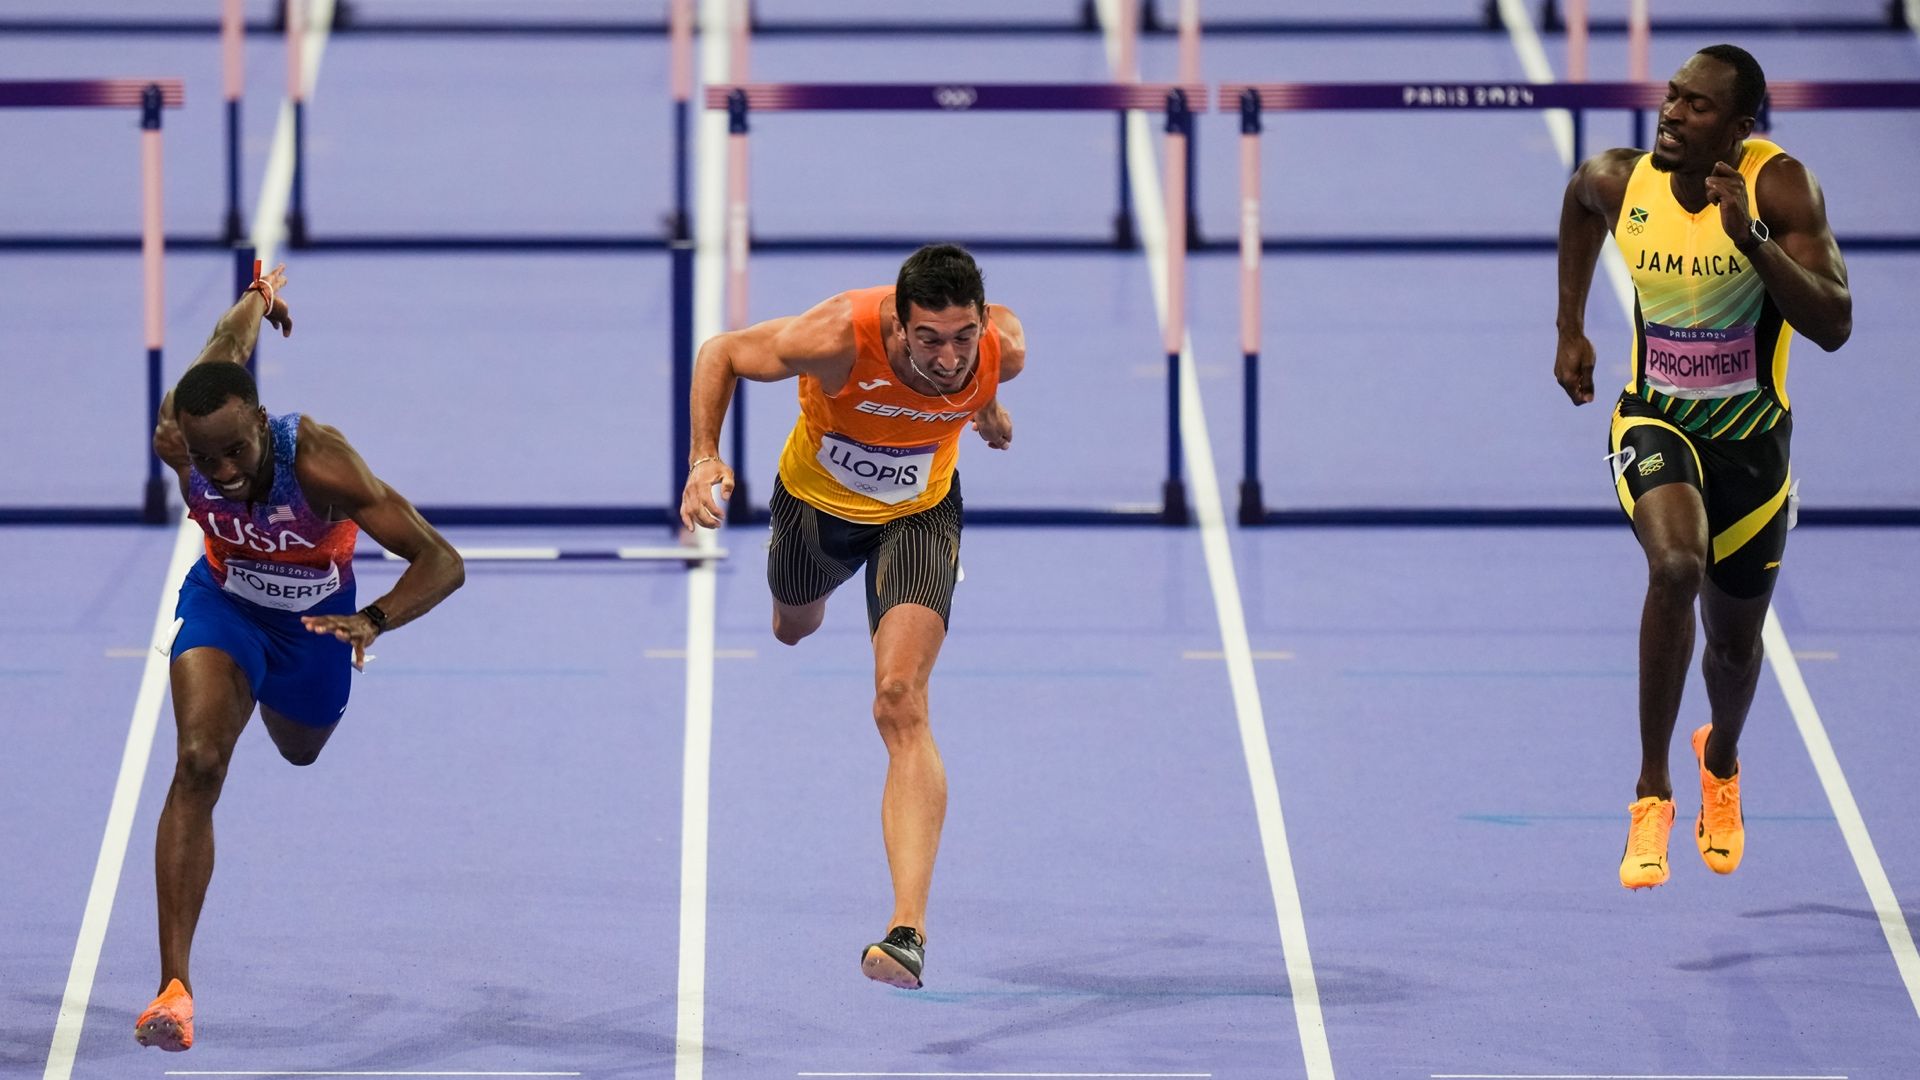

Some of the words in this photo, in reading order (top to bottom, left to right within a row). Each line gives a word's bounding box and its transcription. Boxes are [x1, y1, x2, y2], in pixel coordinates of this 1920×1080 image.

[1402, 86, 1469, 107] PARIS
[1474, 86, 1534, 107] 2024
[1635, 249, 1743, 277] JAMAICA
[1669, 329, 1697, 339] PARIS
[1700, 330, 1727, 340] 2024
[1649, 348, 1751, 378] PARCHMENT
[829, 444, 919, 487] LLOPIS
[207, 511, 316, 554] USA
[231, 566, 338, 600] ROBERTS
[255, 562, 285, 574] PARIS
[288, 567, 315, 578] 2024
